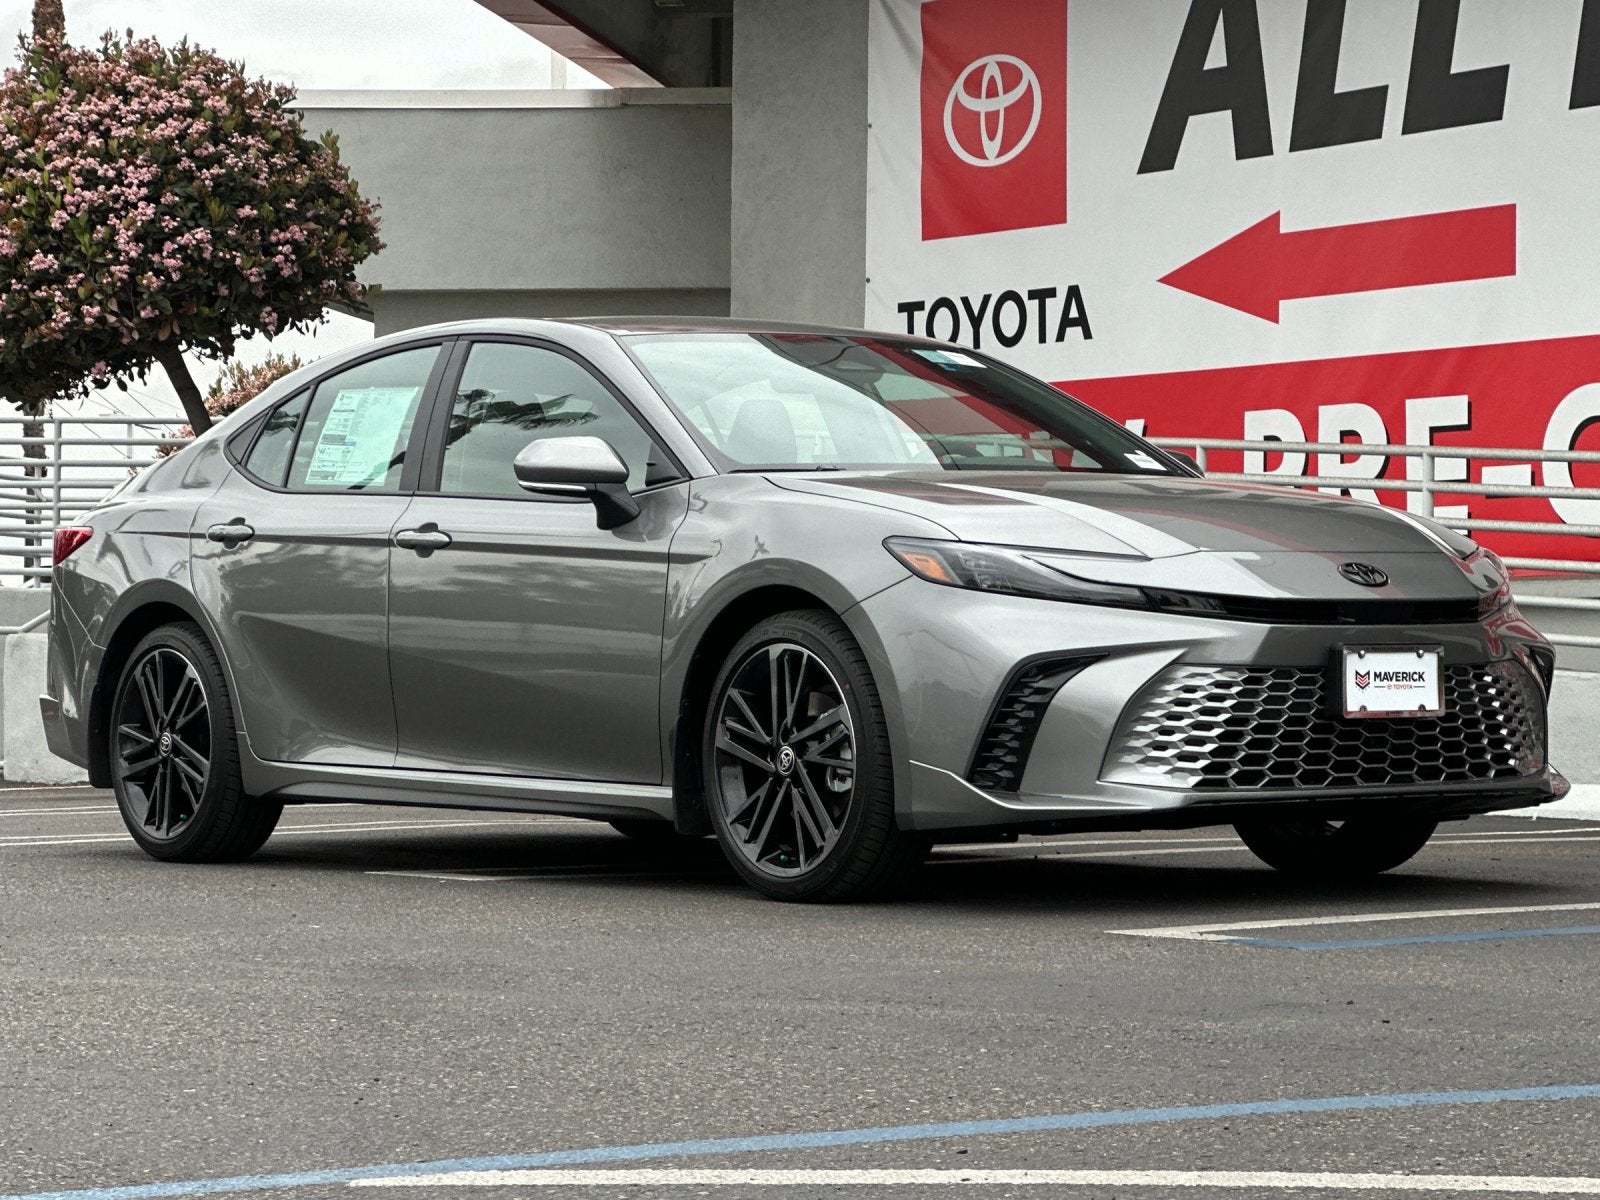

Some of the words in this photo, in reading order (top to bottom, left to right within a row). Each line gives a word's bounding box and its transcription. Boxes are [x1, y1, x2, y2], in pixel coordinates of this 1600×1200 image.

[1137, 0, 1510, 175] ALL
[898, 284, 1093, 350] TOYOTA
[1373, 671, 1426, 682] MAVERICK
